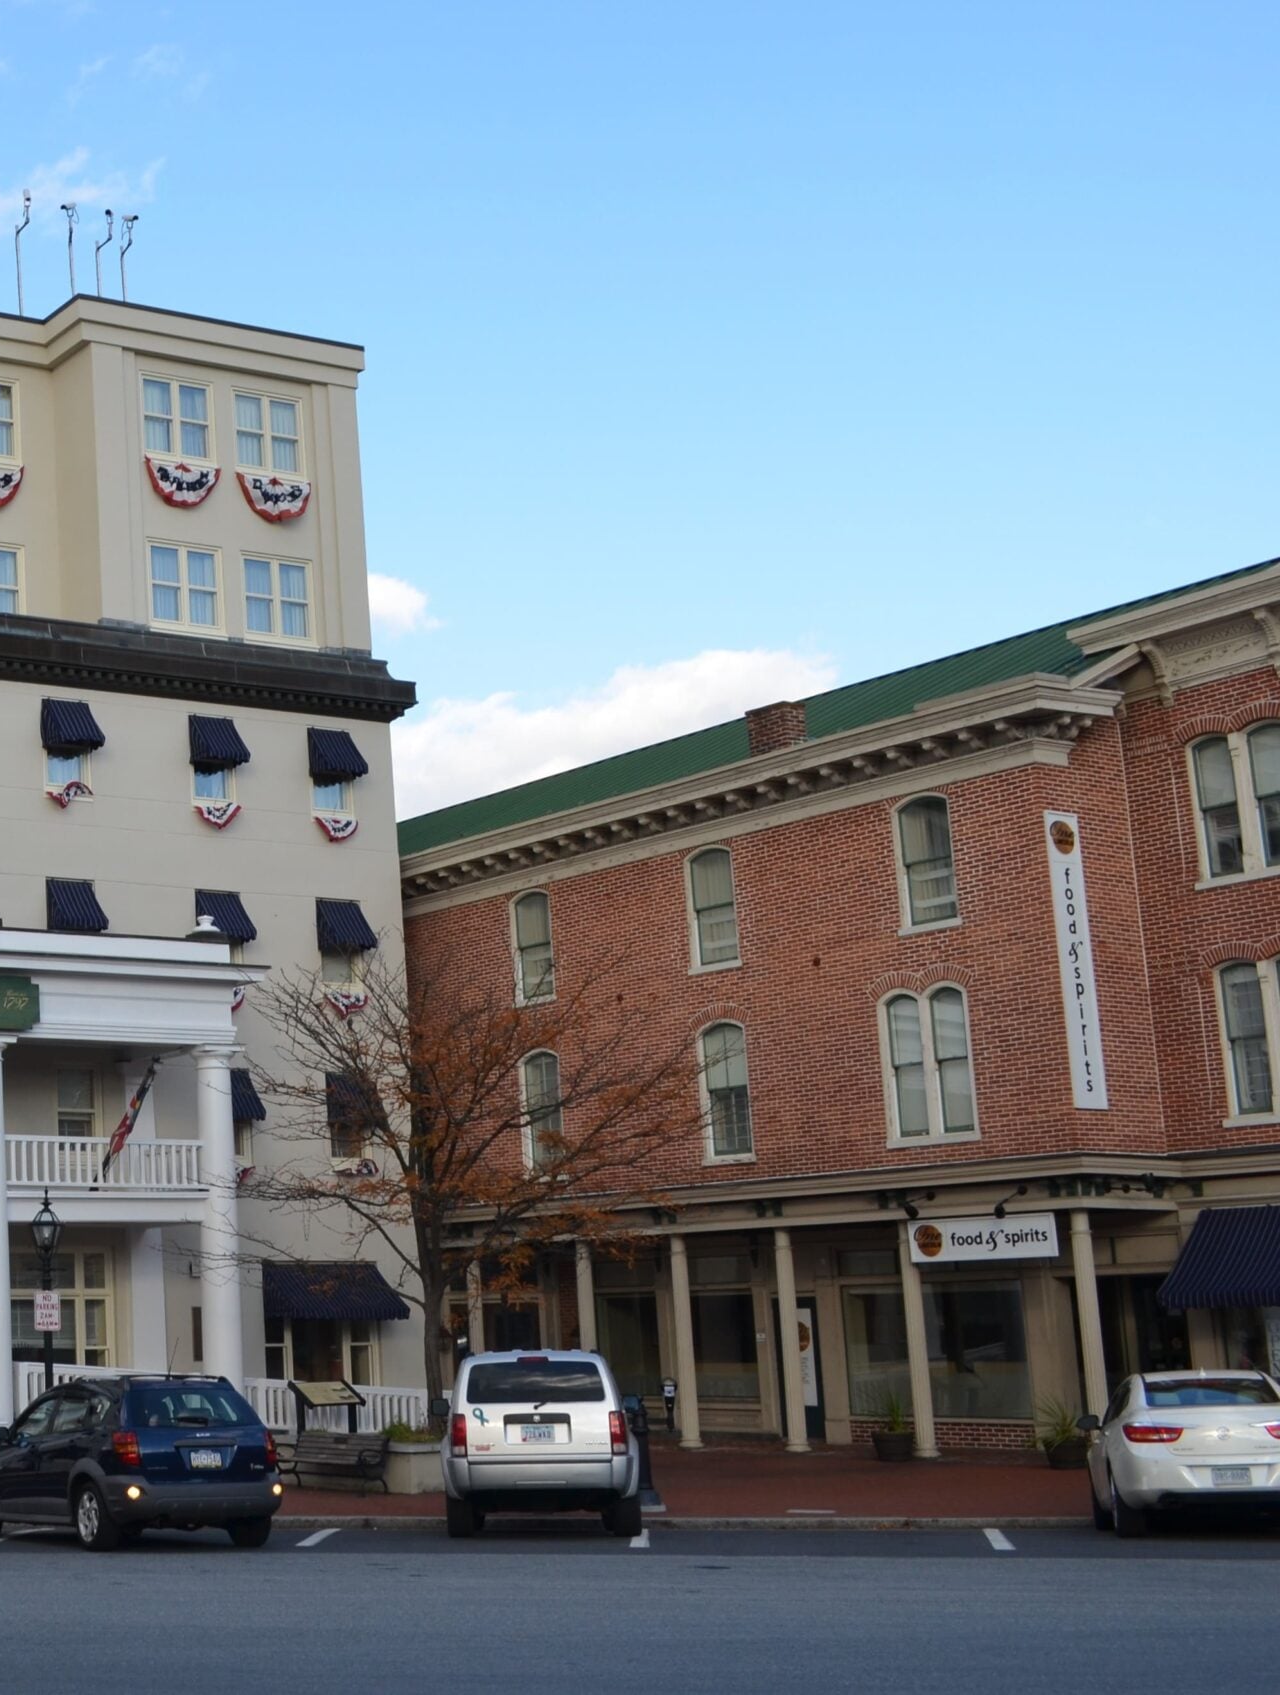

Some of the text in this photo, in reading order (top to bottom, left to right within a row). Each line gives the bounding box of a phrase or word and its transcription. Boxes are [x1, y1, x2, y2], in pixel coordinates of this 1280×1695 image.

[1064, 867, 1093, 1092] food & spirits
[950, 1228, 1048, 1251] food & spirits
[42, 1294, 52, 1302] NO
